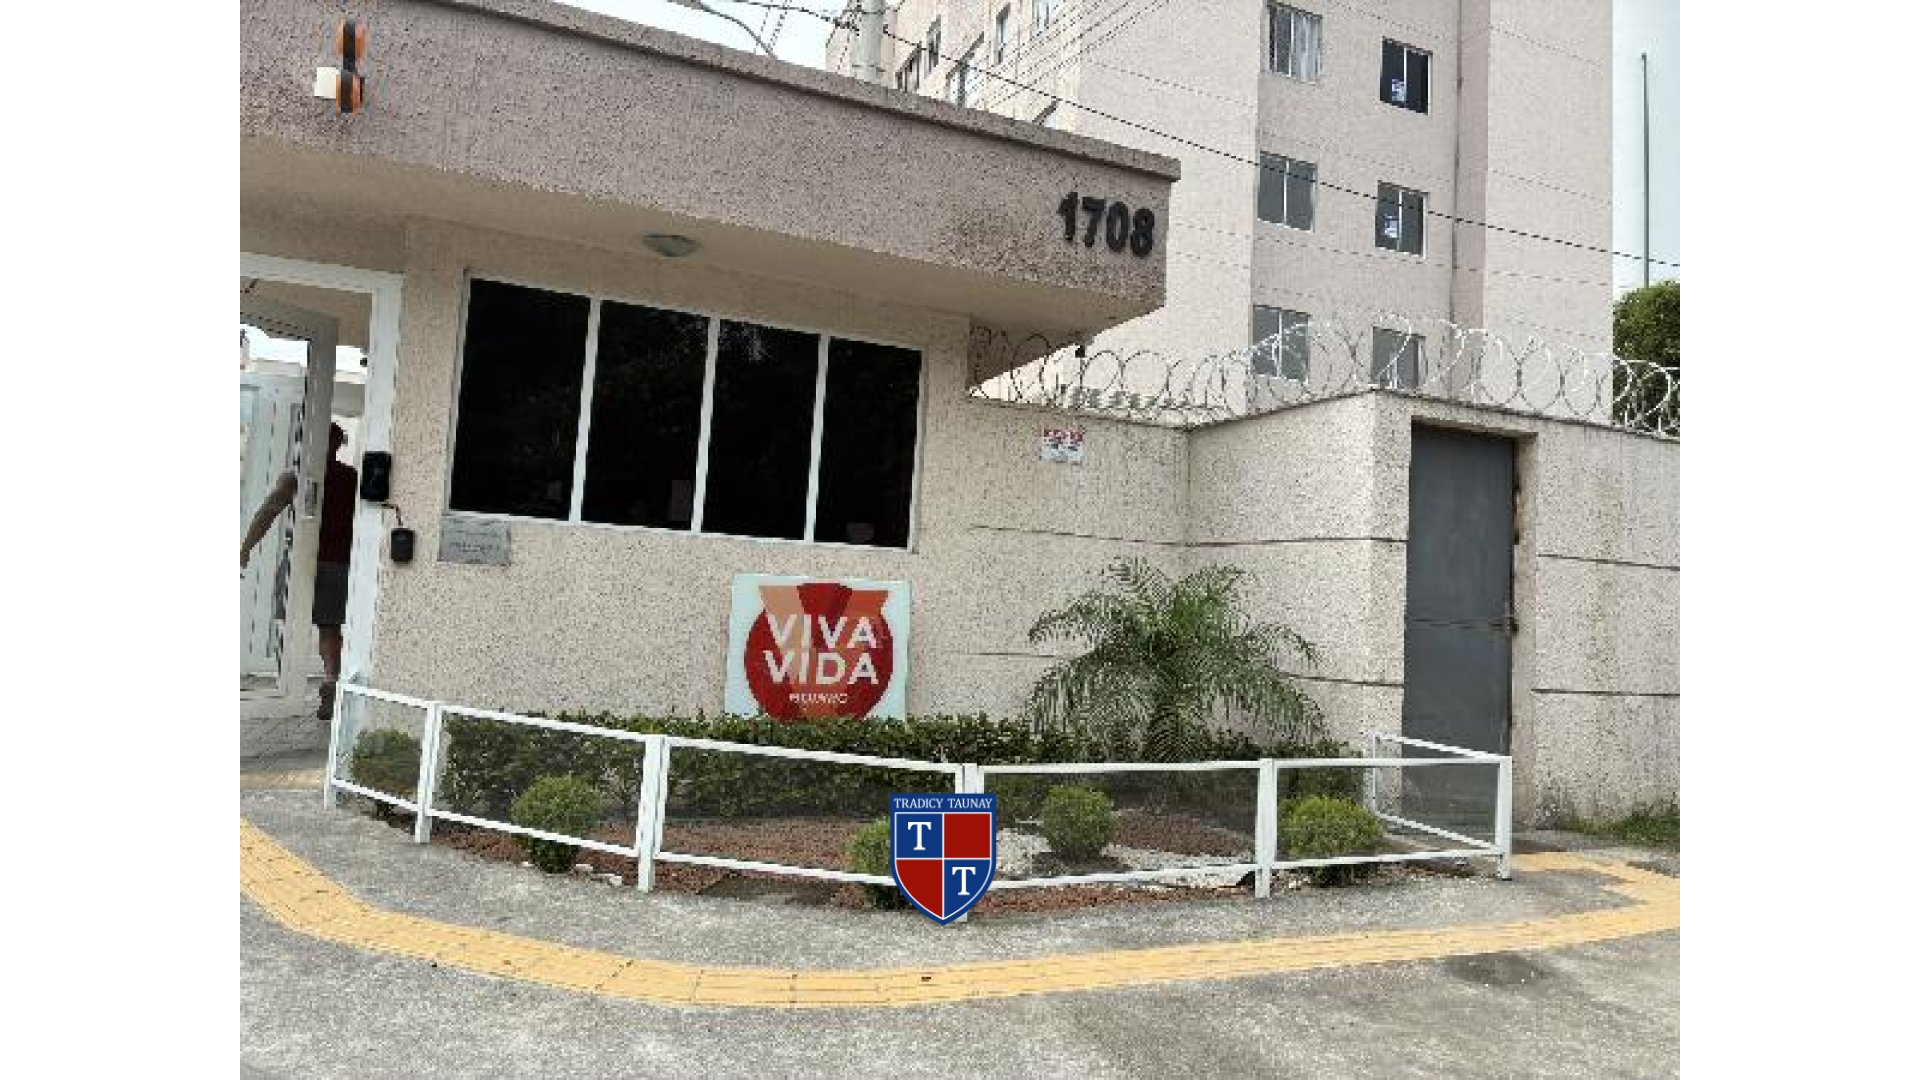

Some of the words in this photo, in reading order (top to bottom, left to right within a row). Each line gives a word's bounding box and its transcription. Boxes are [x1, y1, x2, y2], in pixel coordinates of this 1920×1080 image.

[1057, 192, 1155, 259] 1708
[766, 614, 878, 649] VIVA
[763, 650, 879, 685] VIDA
